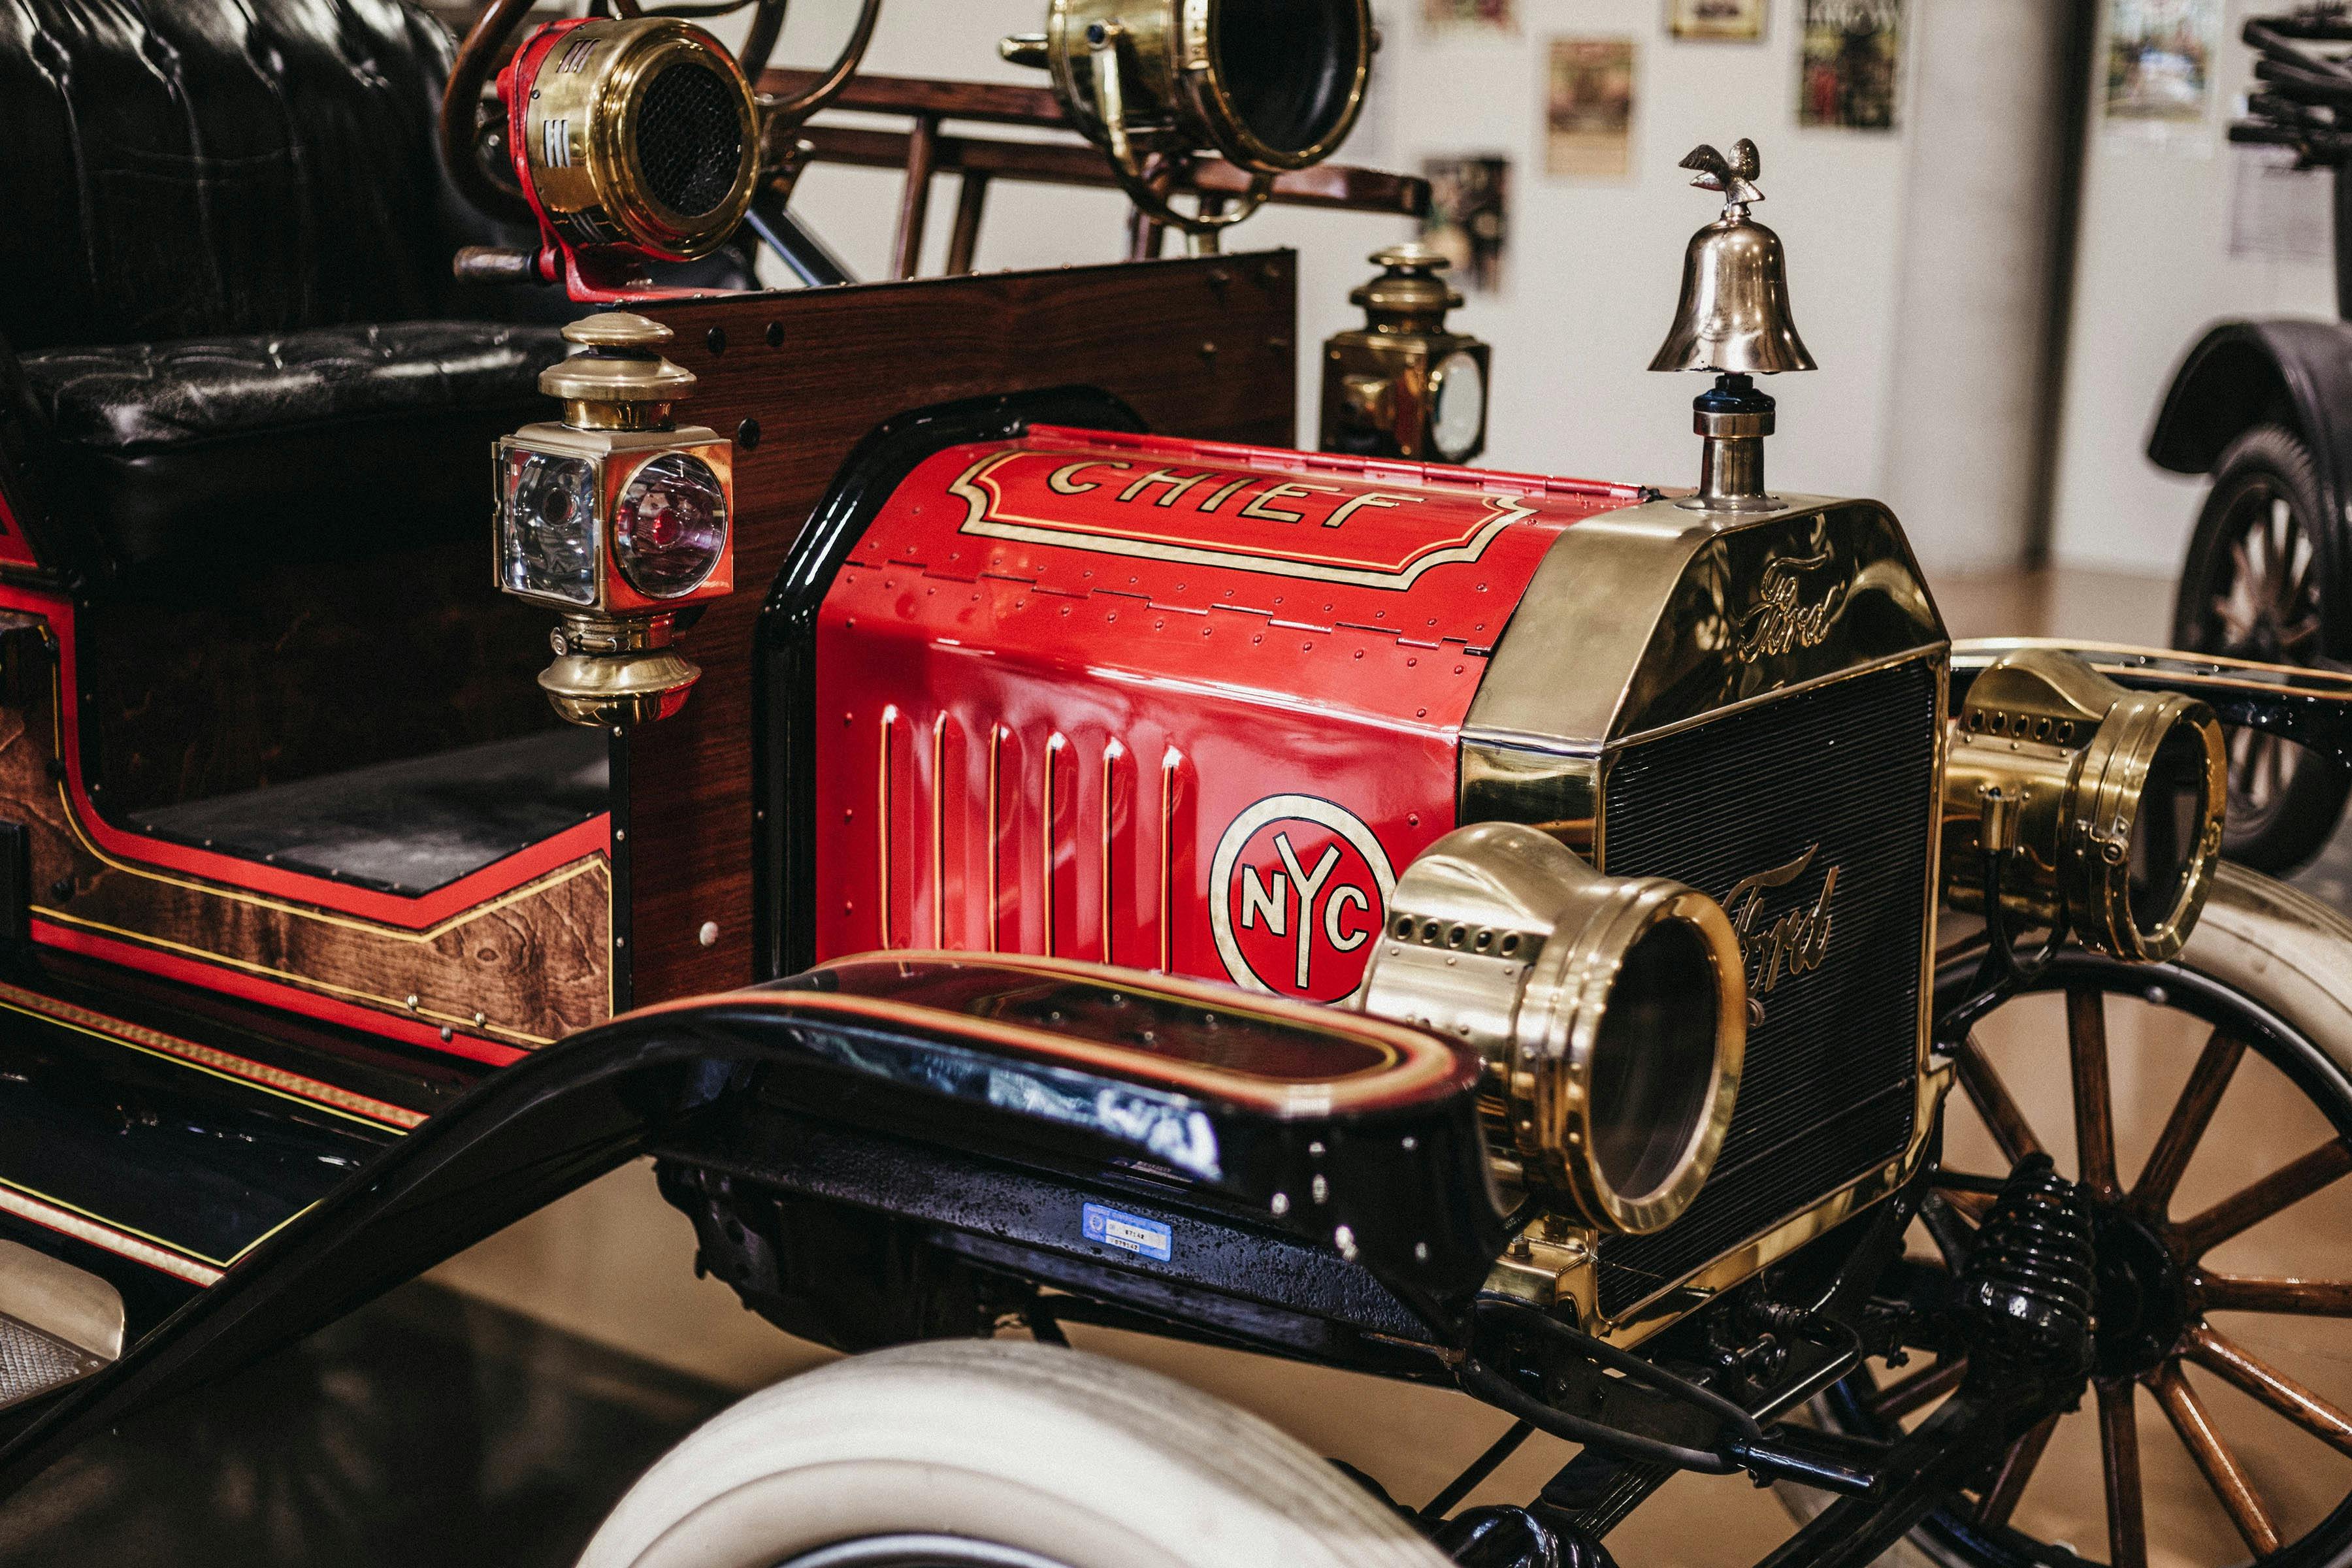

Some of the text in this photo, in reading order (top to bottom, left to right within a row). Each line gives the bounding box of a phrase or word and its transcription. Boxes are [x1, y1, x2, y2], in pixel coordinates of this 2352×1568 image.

[1047, 459, 1428, 529] CHIEF
[1737, 556, 1838, 663] Ford
[1241, 830, 1369, 990] NYC
